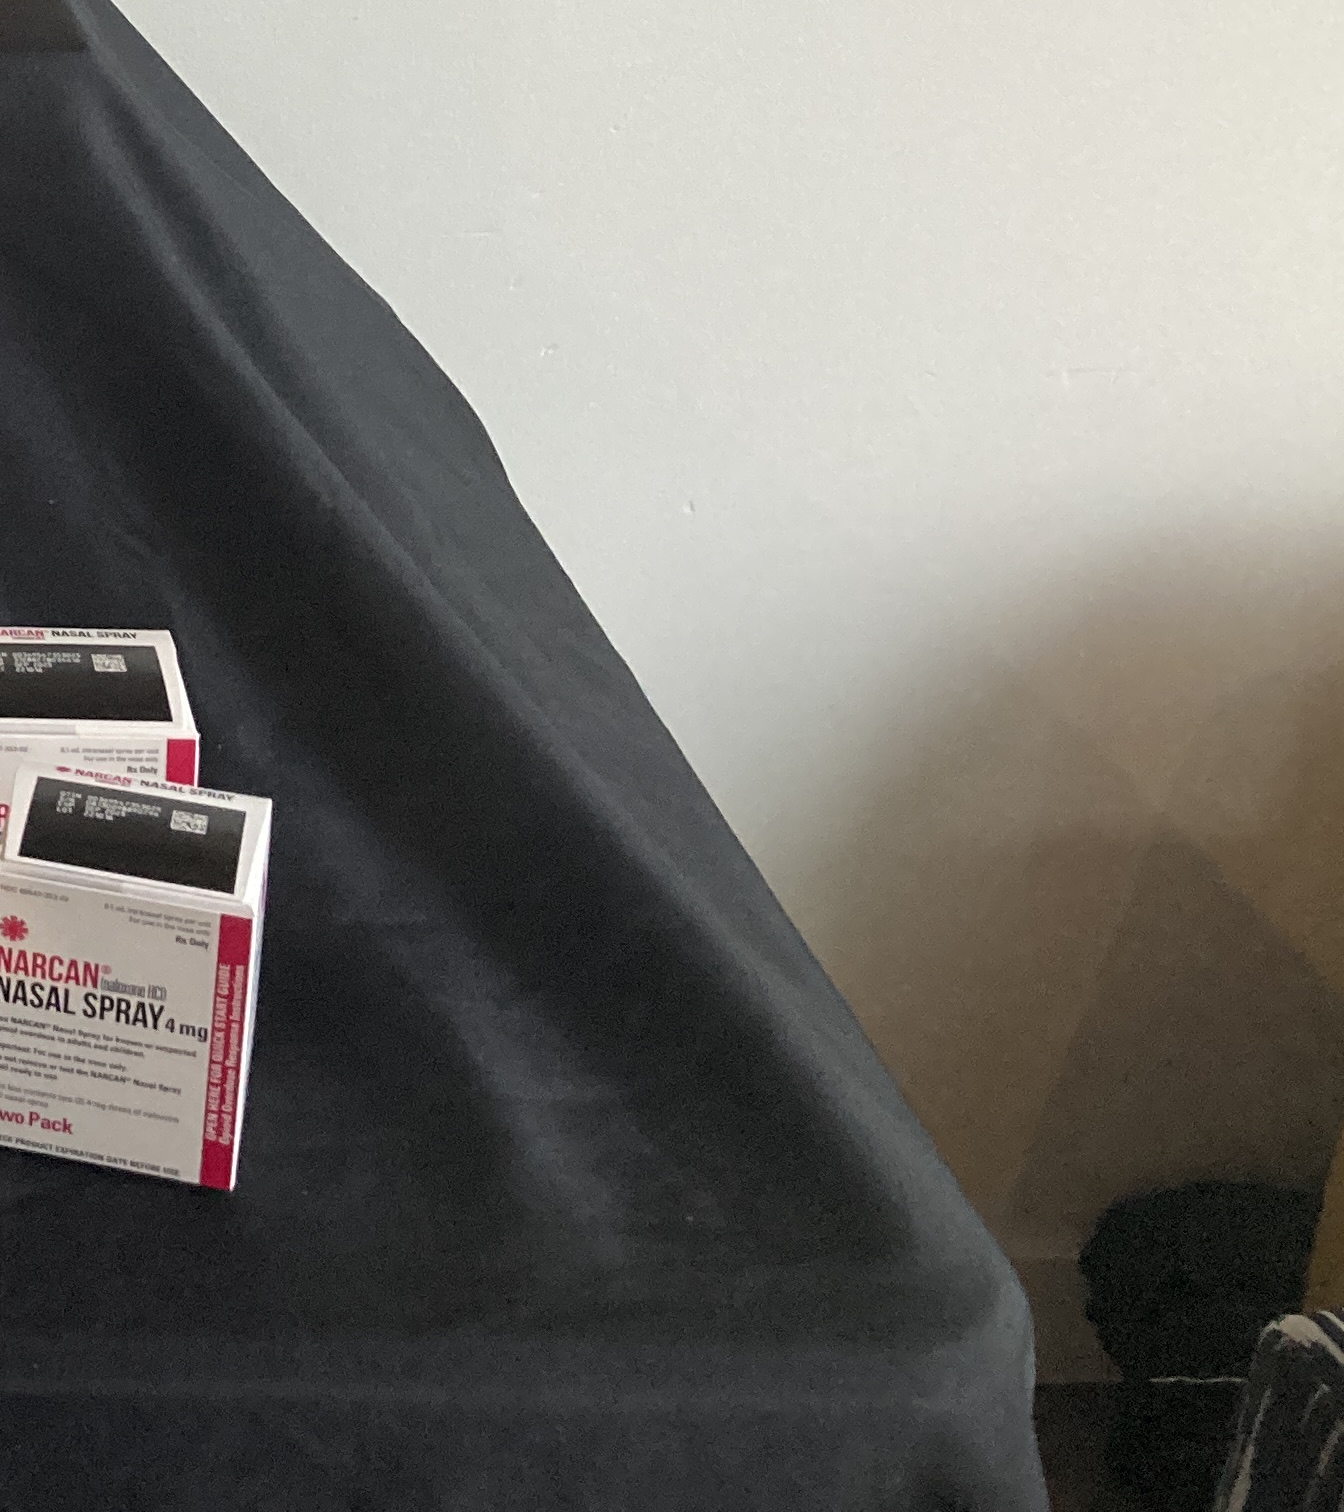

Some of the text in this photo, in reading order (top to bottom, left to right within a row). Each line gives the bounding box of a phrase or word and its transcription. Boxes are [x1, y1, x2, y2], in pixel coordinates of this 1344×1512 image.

[96, 630, 138, 638] SPRAY
[140, 779, 187, 794] NASAL
[190, 788, 236, 802] SPRAY
[82, 990, 164, 1031] SPRAY
[164, 1017, 175, 1033] 4
[178, 1022, 208, 1042] mg
[28, 1110, 73, 1134] Pack
